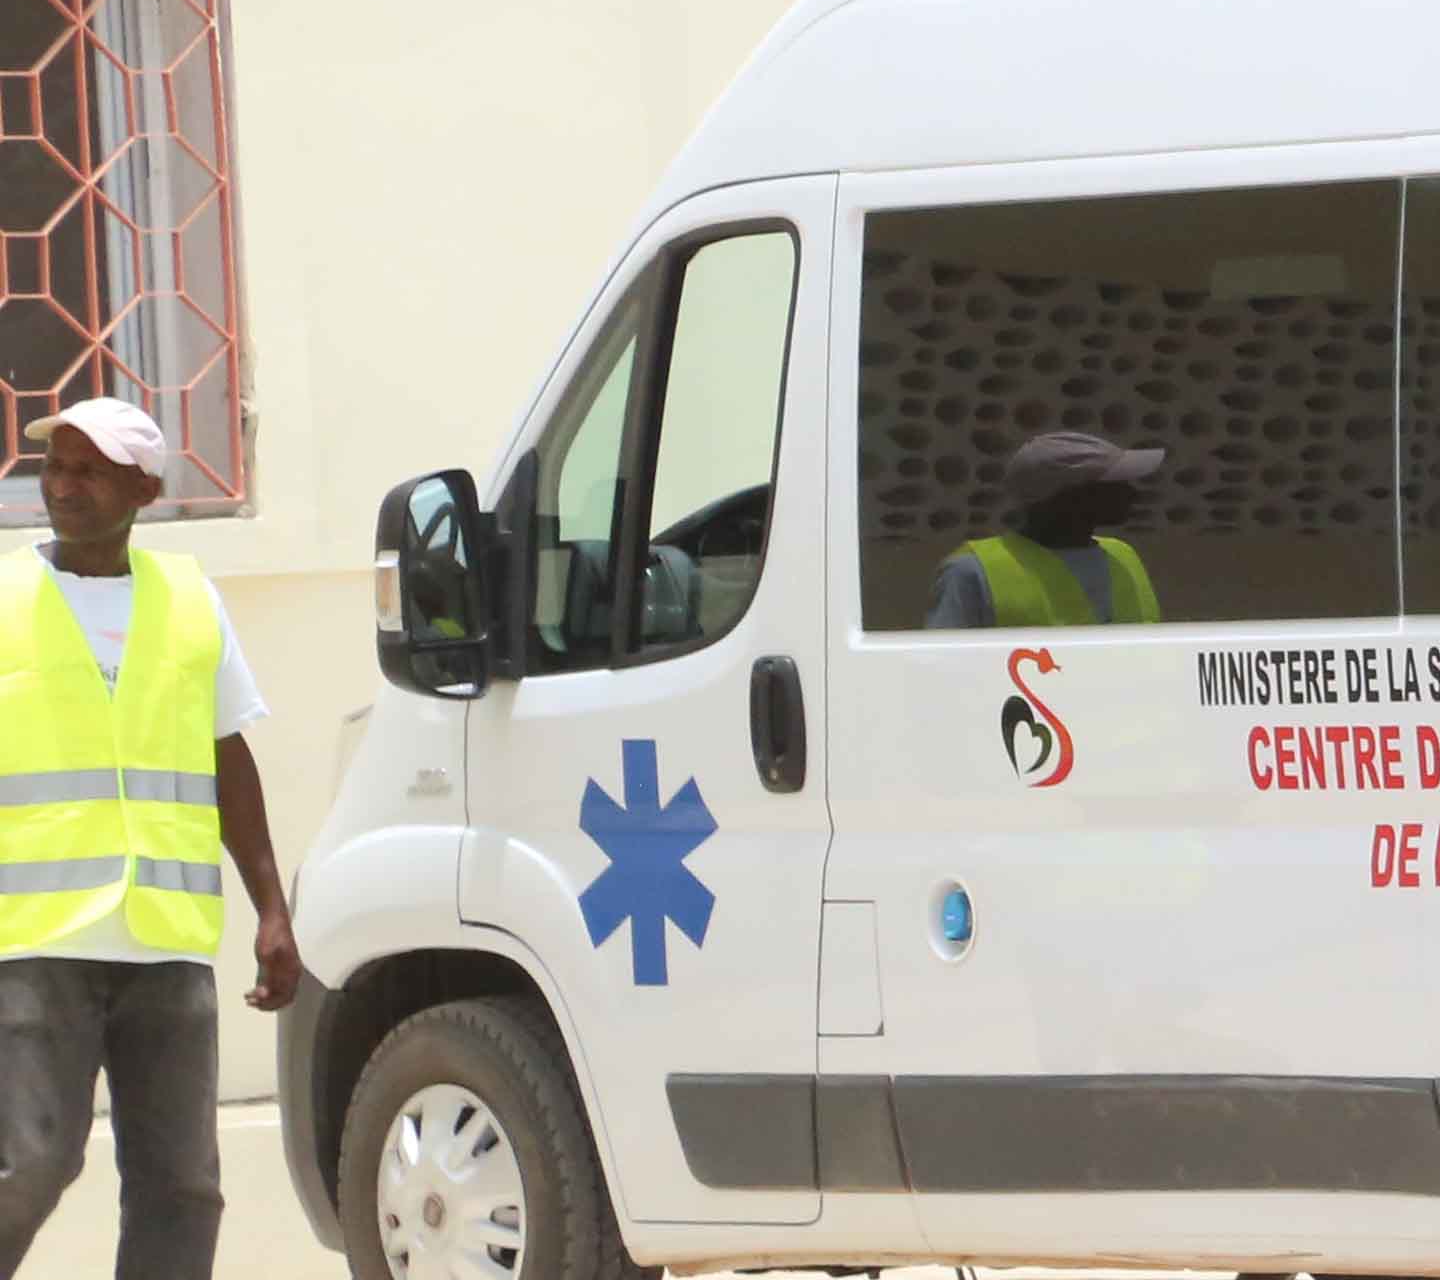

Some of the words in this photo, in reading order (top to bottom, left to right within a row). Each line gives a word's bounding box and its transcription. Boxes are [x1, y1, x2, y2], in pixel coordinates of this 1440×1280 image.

[1197, 649, 1338, 706] MINISTERE
[1345, 648, 1380, 703] DE
[1386, 647, 1421, 702] LA
[1247, 724, 1406, 791] CENTRE
[1371, 823, 1424, 889] DE
